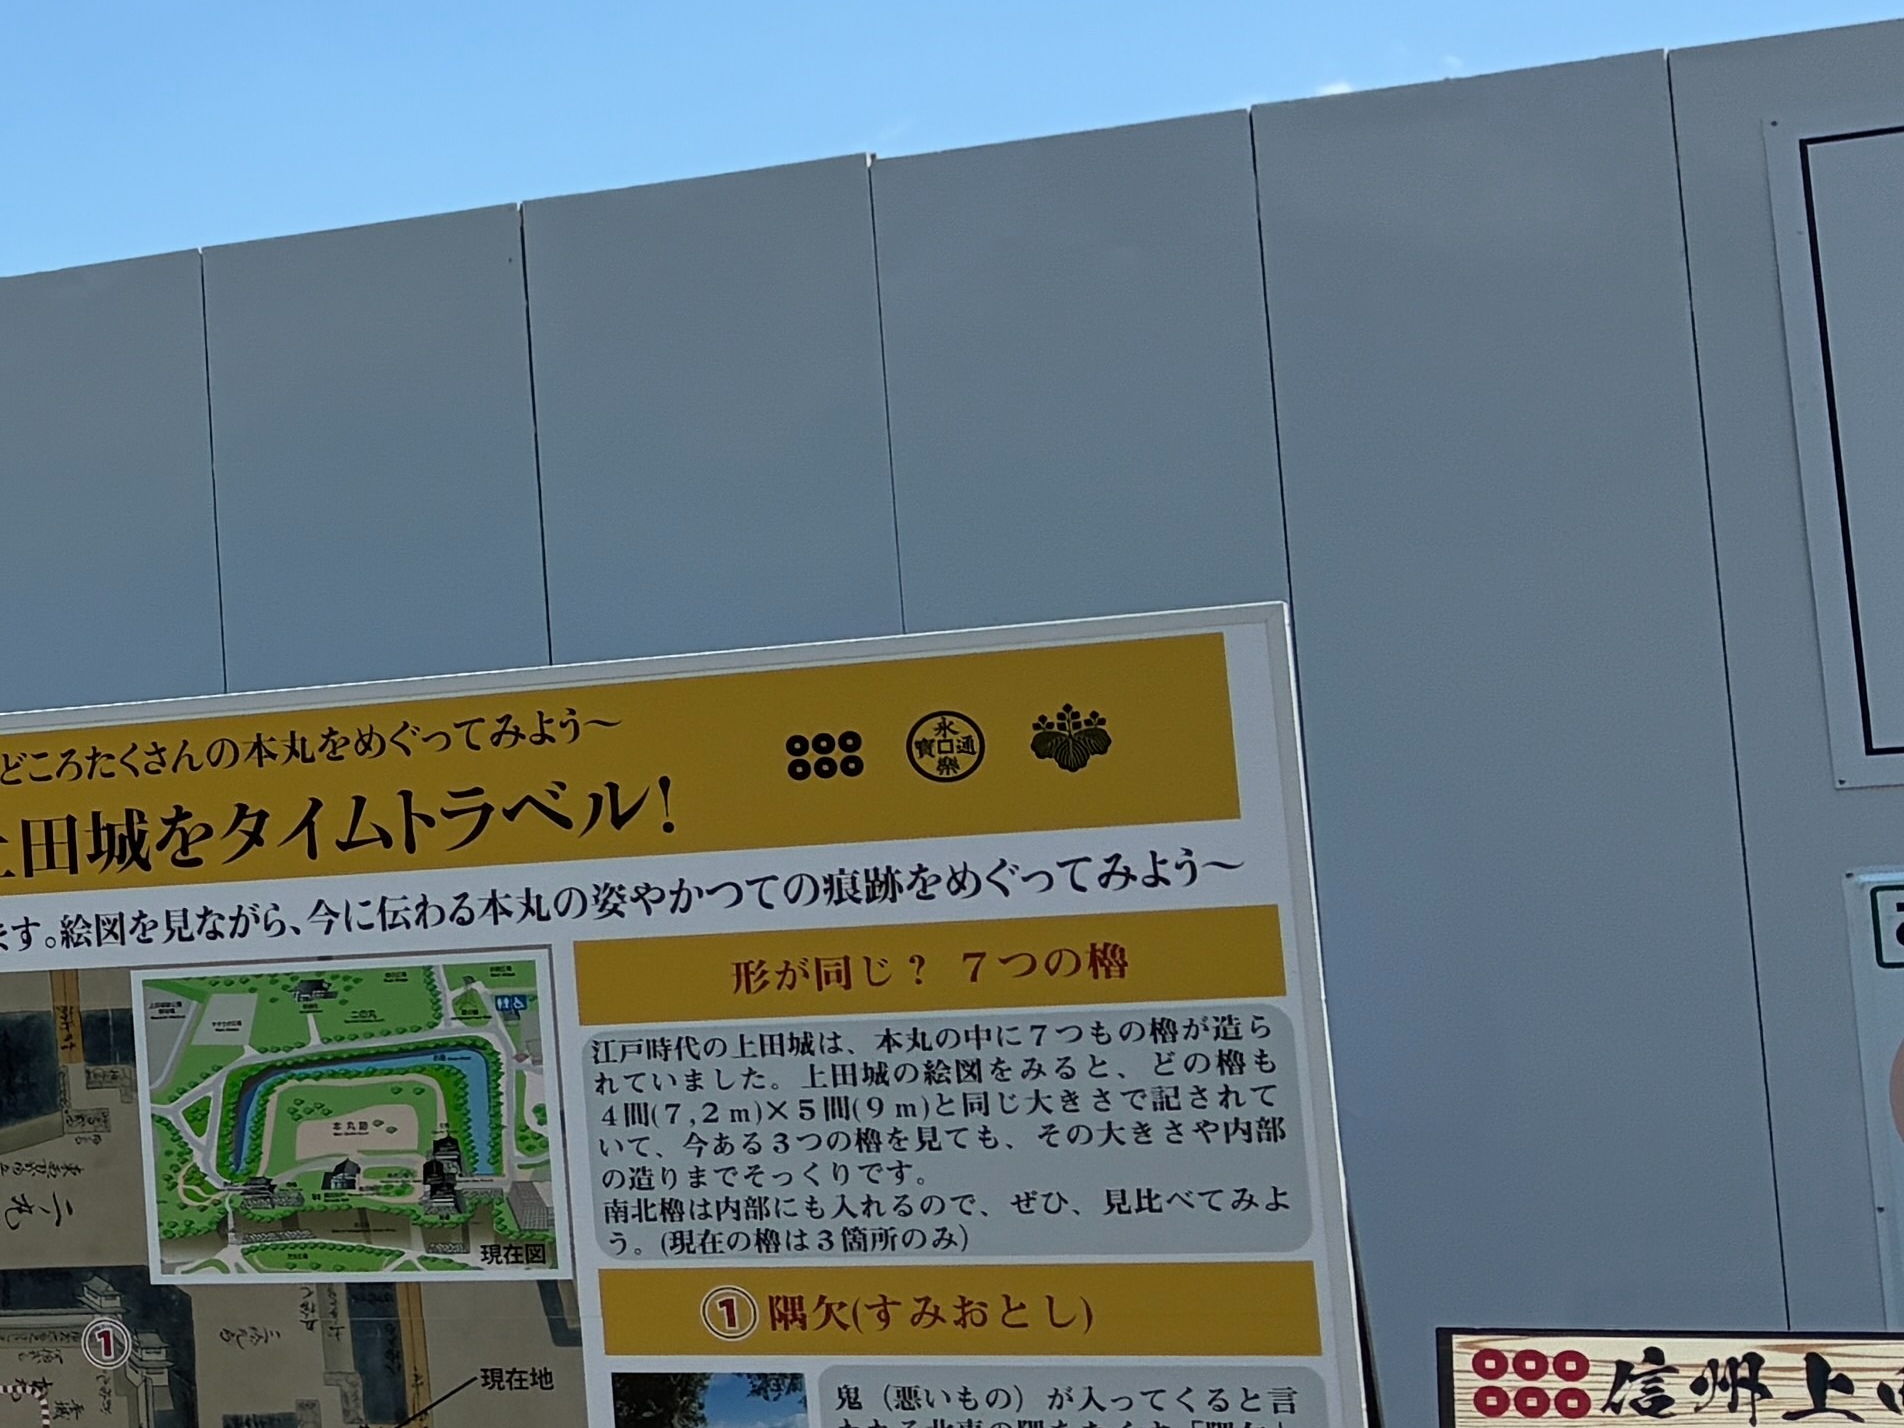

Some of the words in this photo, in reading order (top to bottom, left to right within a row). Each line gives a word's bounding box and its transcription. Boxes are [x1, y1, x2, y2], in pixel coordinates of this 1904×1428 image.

[602, 1160, 926, 1190] の造りまでそっくりです。
[480, 1244, 545, 1265] 現在図
[481, 1368, 554, 1392] 現在地
[1601, 1346, 1904, 1427] 信州上
